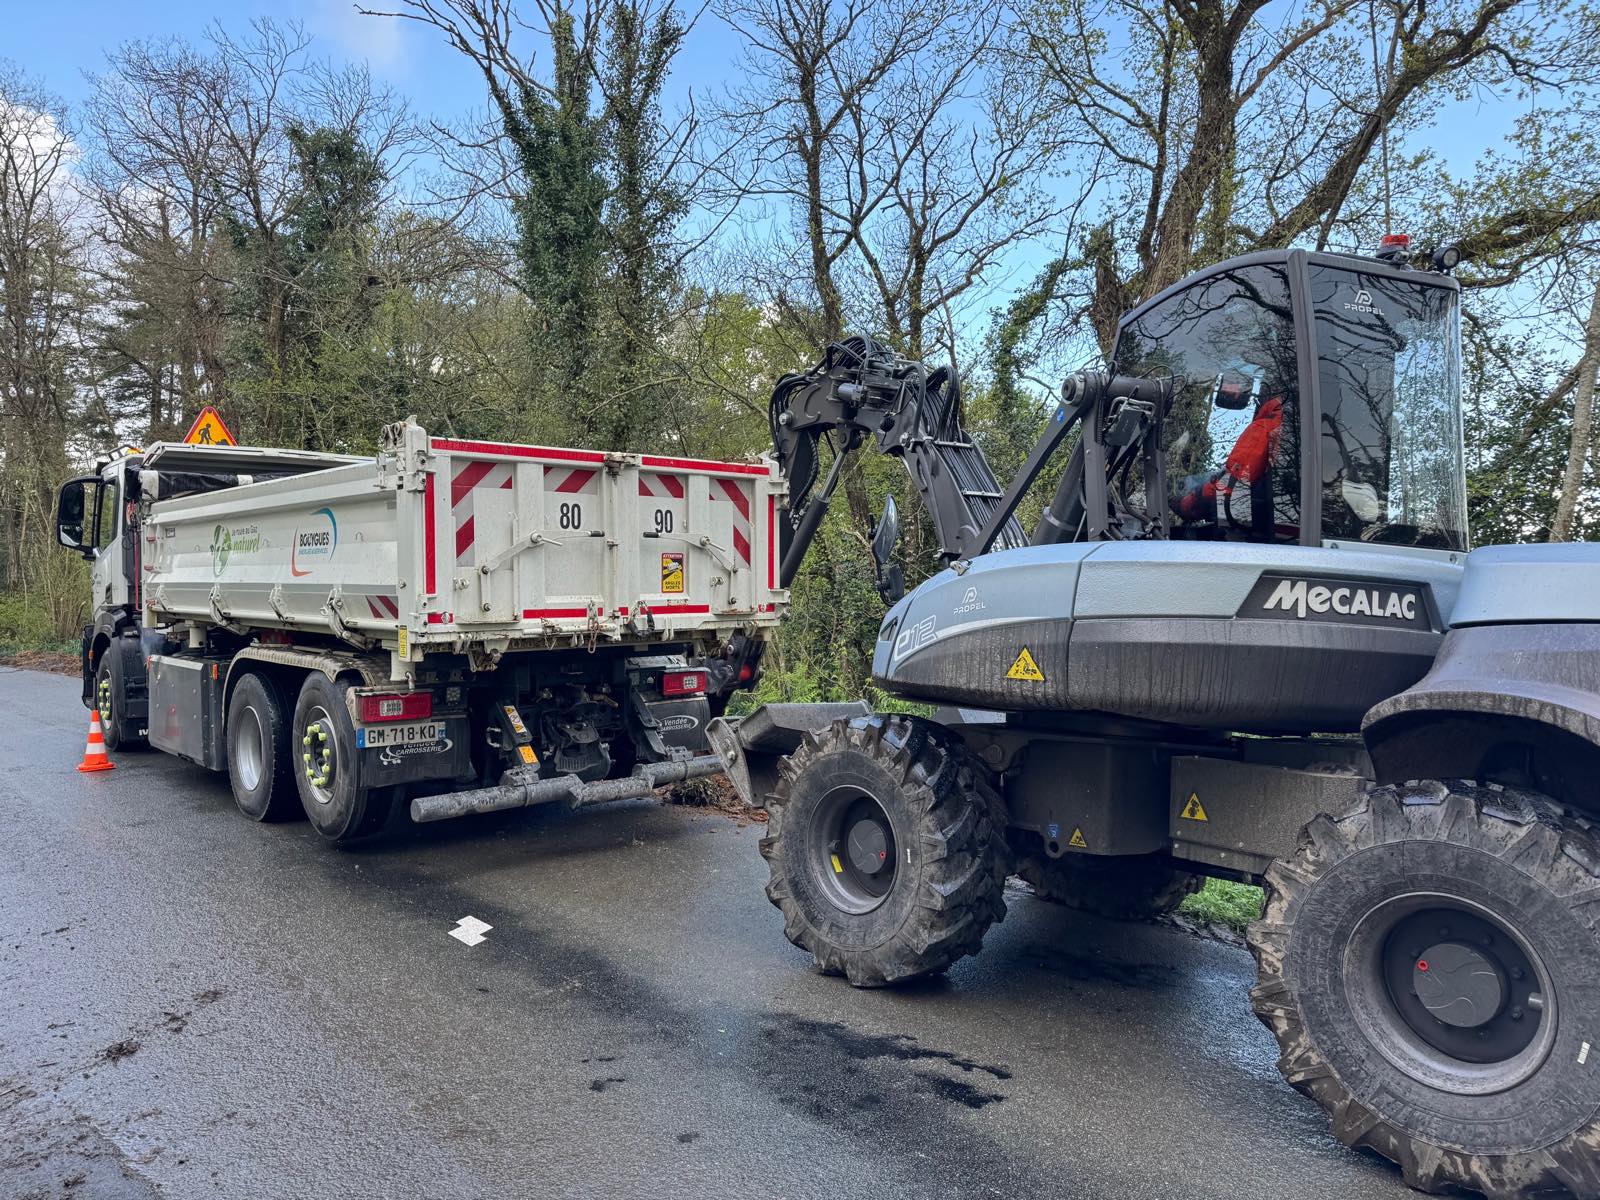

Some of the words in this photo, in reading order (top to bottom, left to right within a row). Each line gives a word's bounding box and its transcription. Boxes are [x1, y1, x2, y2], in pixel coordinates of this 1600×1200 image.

[1343, 302, 1385, 316] PROPEL
[560, 502, 581, 529] 80
[654, 509, 673, 533] 90
[300, 531, 330, 548] BOUYGUES
[953, 602, 986, 615] PROPEL
[396, 746, 442, 756] CARROSSERIE
